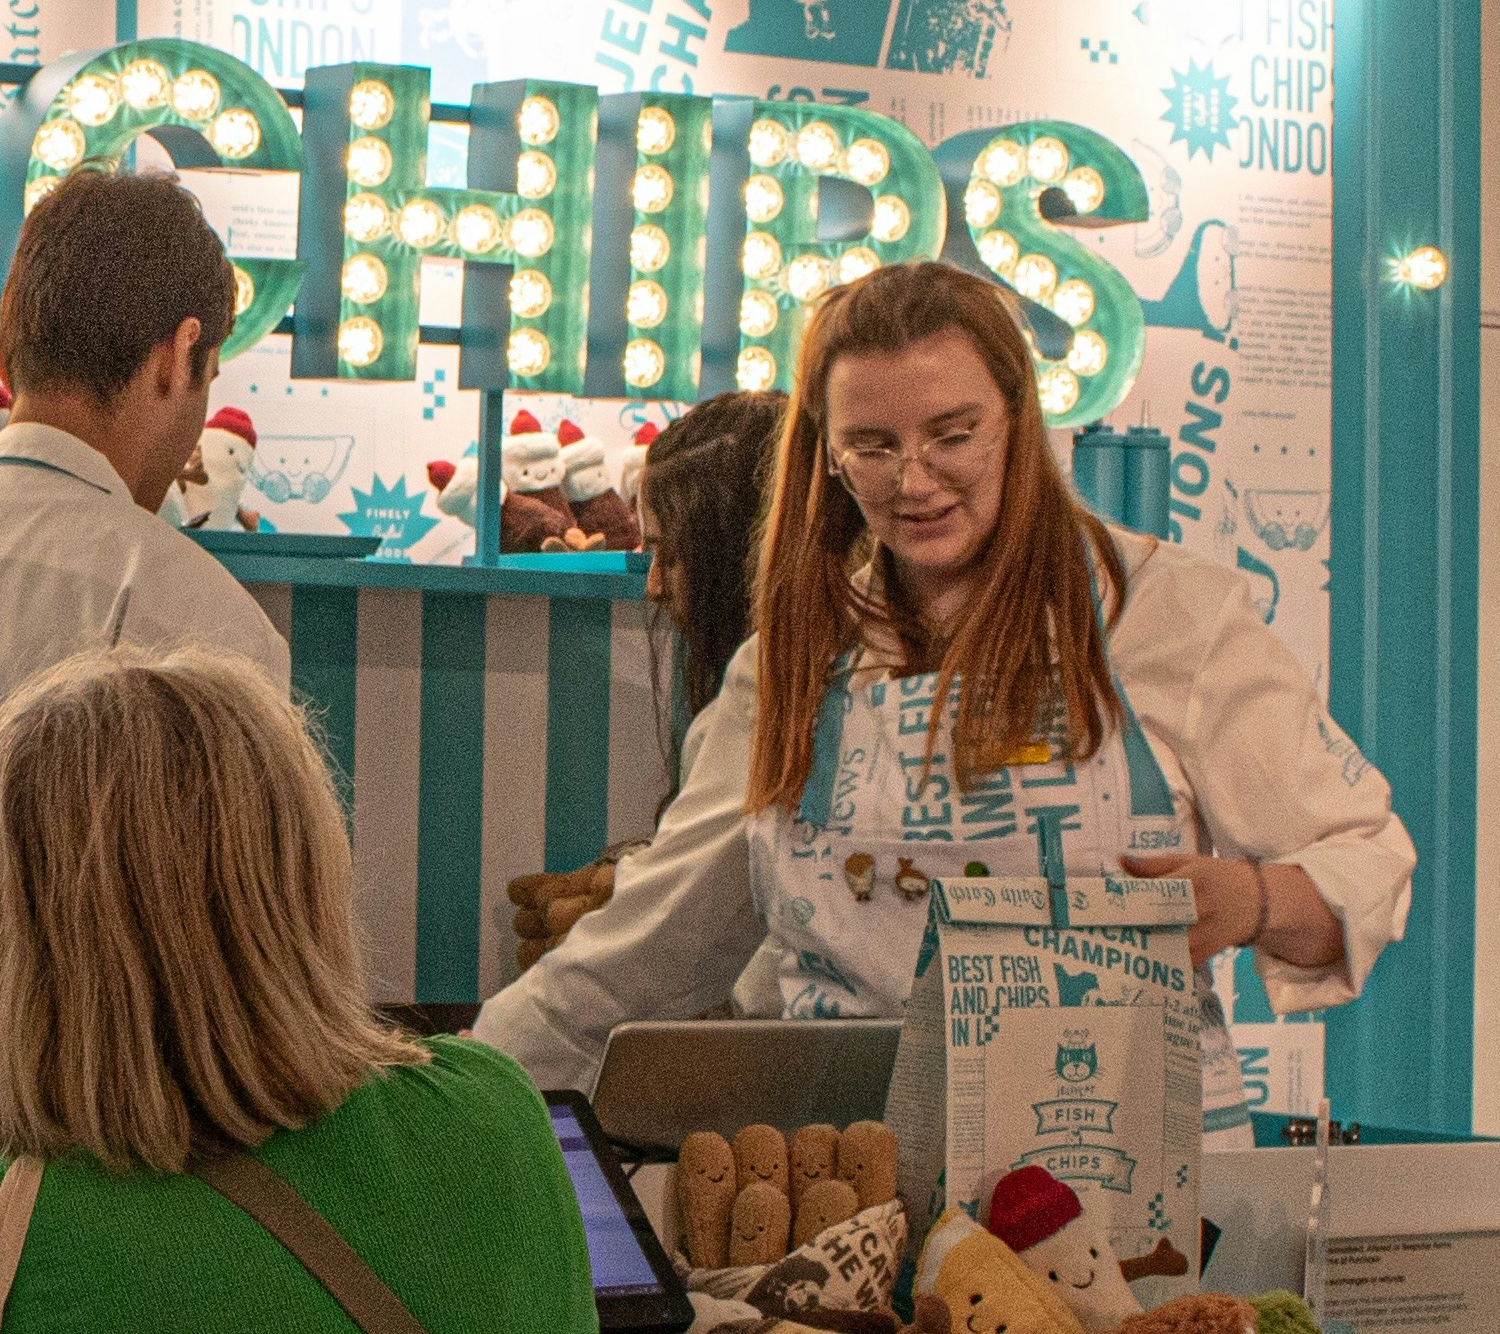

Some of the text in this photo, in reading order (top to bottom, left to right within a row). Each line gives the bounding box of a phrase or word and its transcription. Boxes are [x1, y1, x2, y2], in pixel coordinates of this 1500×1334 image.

[947, 954, 1043, 985] BEST FISH
[1022, 925, 1187, 993] CHAMPIONS
[949, 985, 1050, 1016] AND CHIPS
[952, 1017, 970, 1047] IN
[1054, 1107, 1096, 1122] FISH
[1046, 1155, 1102, 1171] CHIPS
